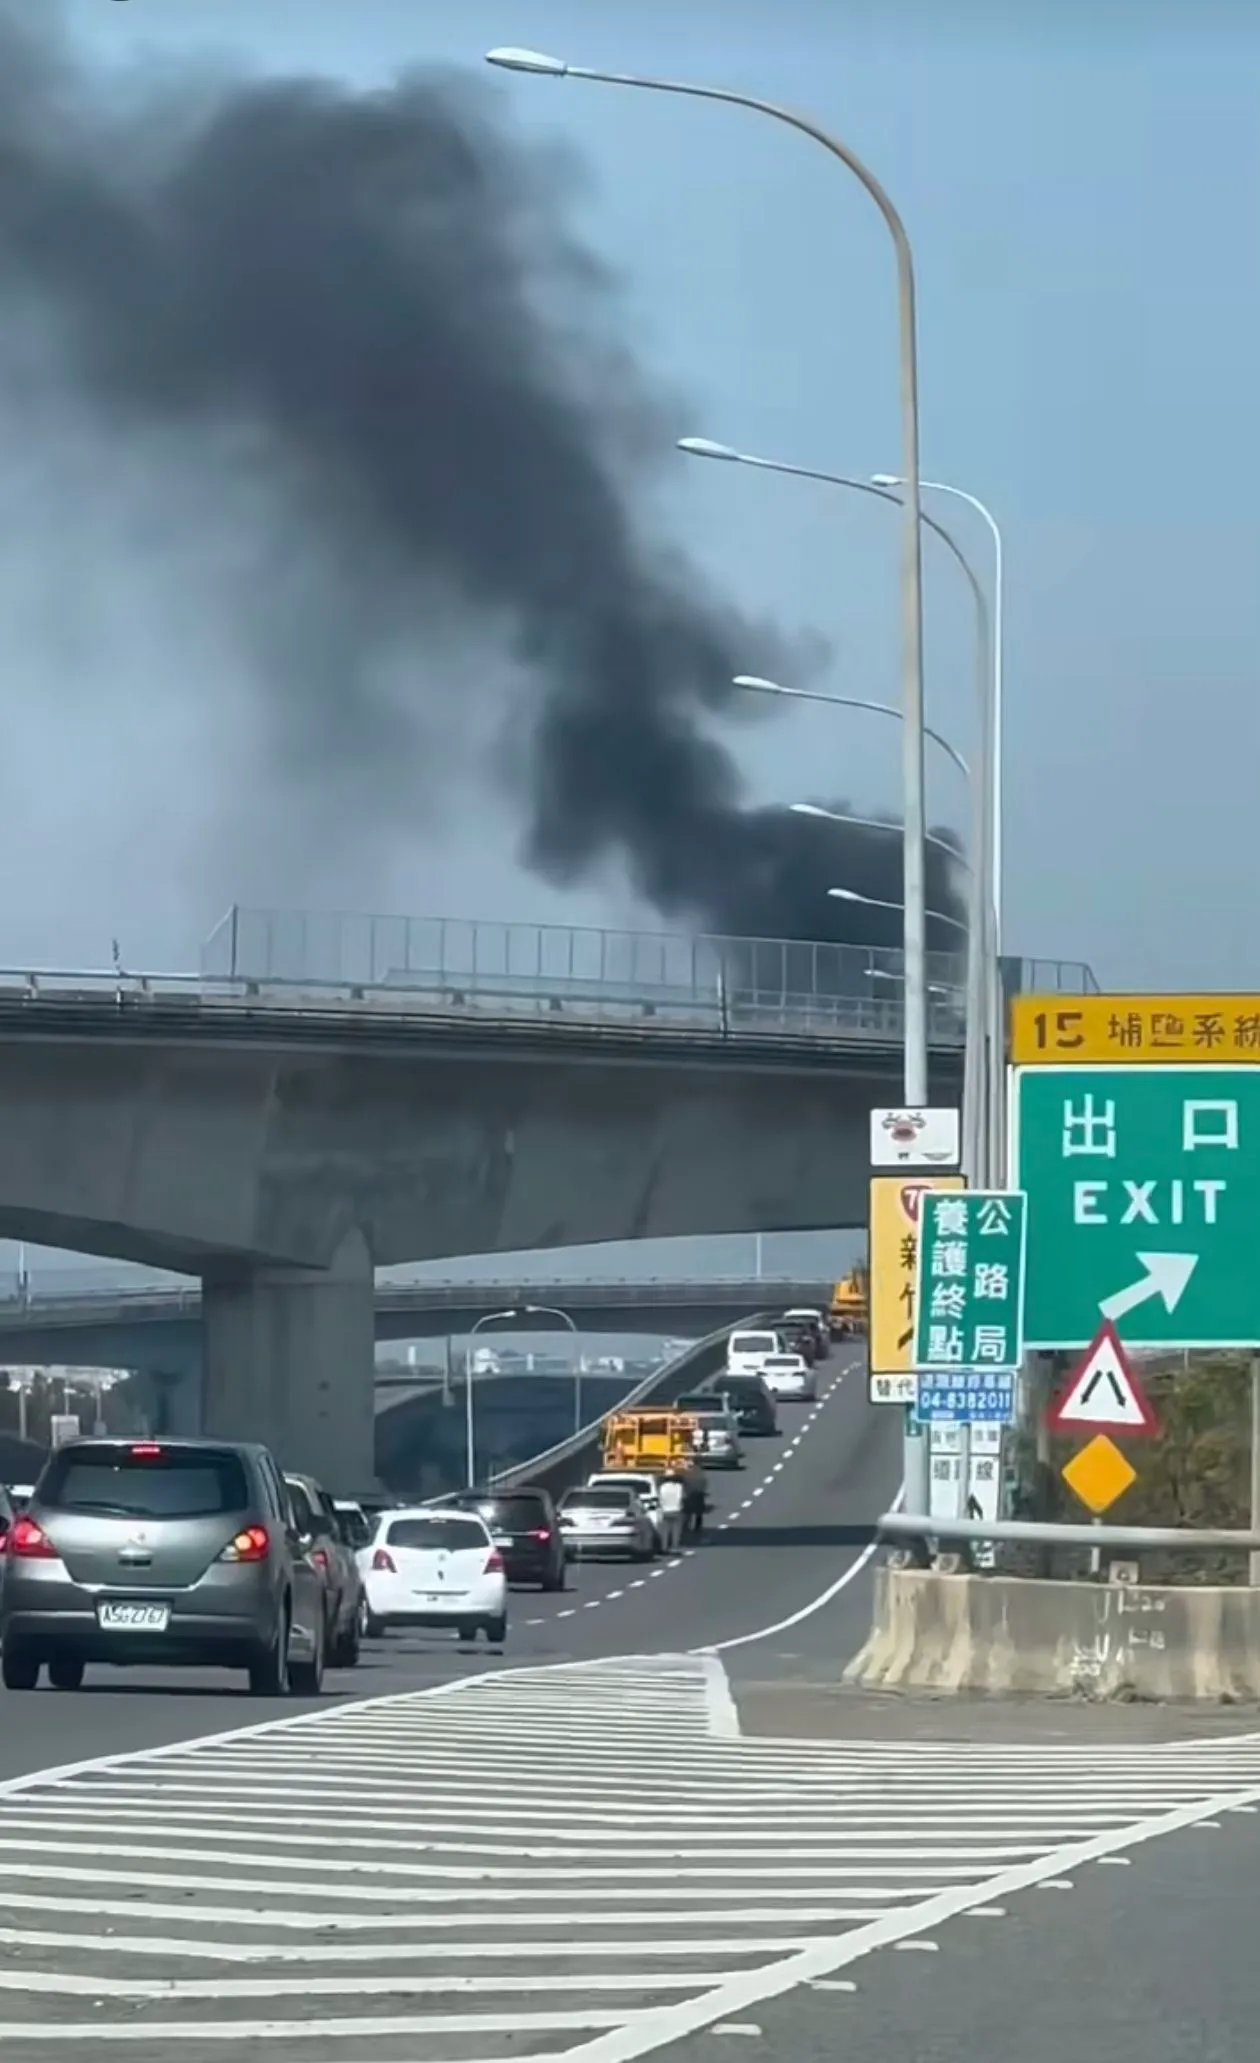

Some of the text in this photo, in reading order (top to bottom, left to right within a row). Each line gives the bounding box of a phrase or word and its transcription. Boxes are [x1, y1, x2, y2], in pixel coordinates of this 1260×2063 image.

[1034, 1012, 1084, 1049] 15
[1062, 1093, 1239, 1158] 出口
[1073, 1180, 1227, 1225] EXIT
[927, 1199, 968, 1362] 養護終點
[970, 1199, 1012, 1362] 公路局
